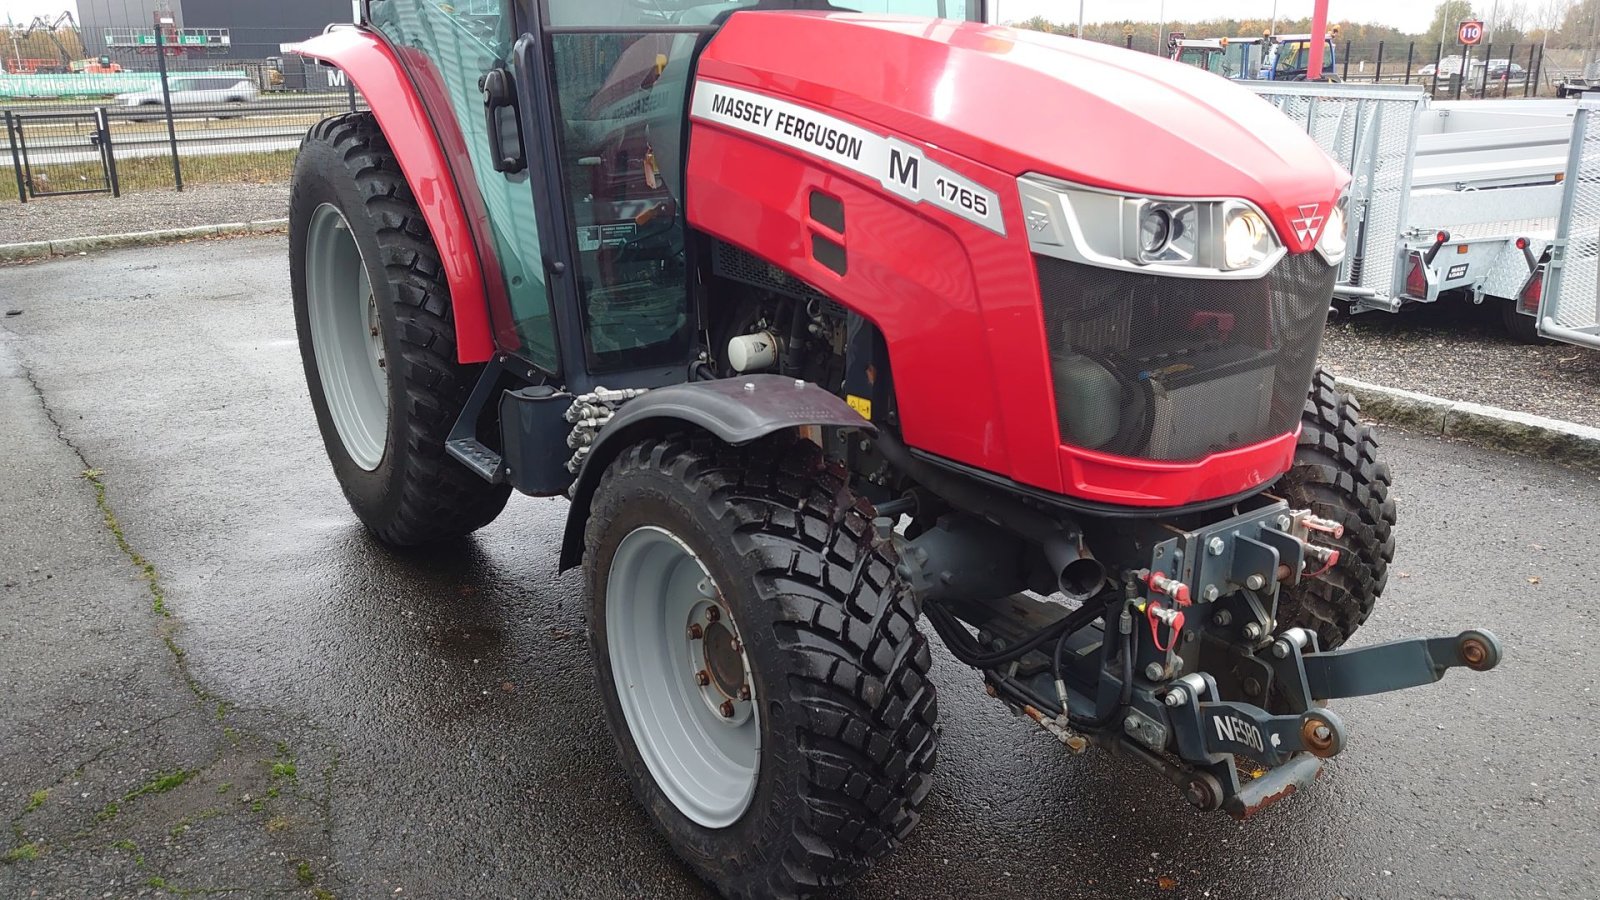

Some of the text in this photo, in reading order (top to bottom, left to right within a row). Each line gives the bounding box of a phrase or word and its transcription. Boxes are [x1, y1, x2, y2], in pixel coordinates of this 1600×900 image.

[1463, 28, 1478, 38] 110
[711, 93, 773, 128] MASSEY
[775, 111, 863, 161] FERGUSON
[888, 148, 919, 190] M
[936, 177, 987, 216] 1765
[1213, 715, 1264, 752] NESBO
